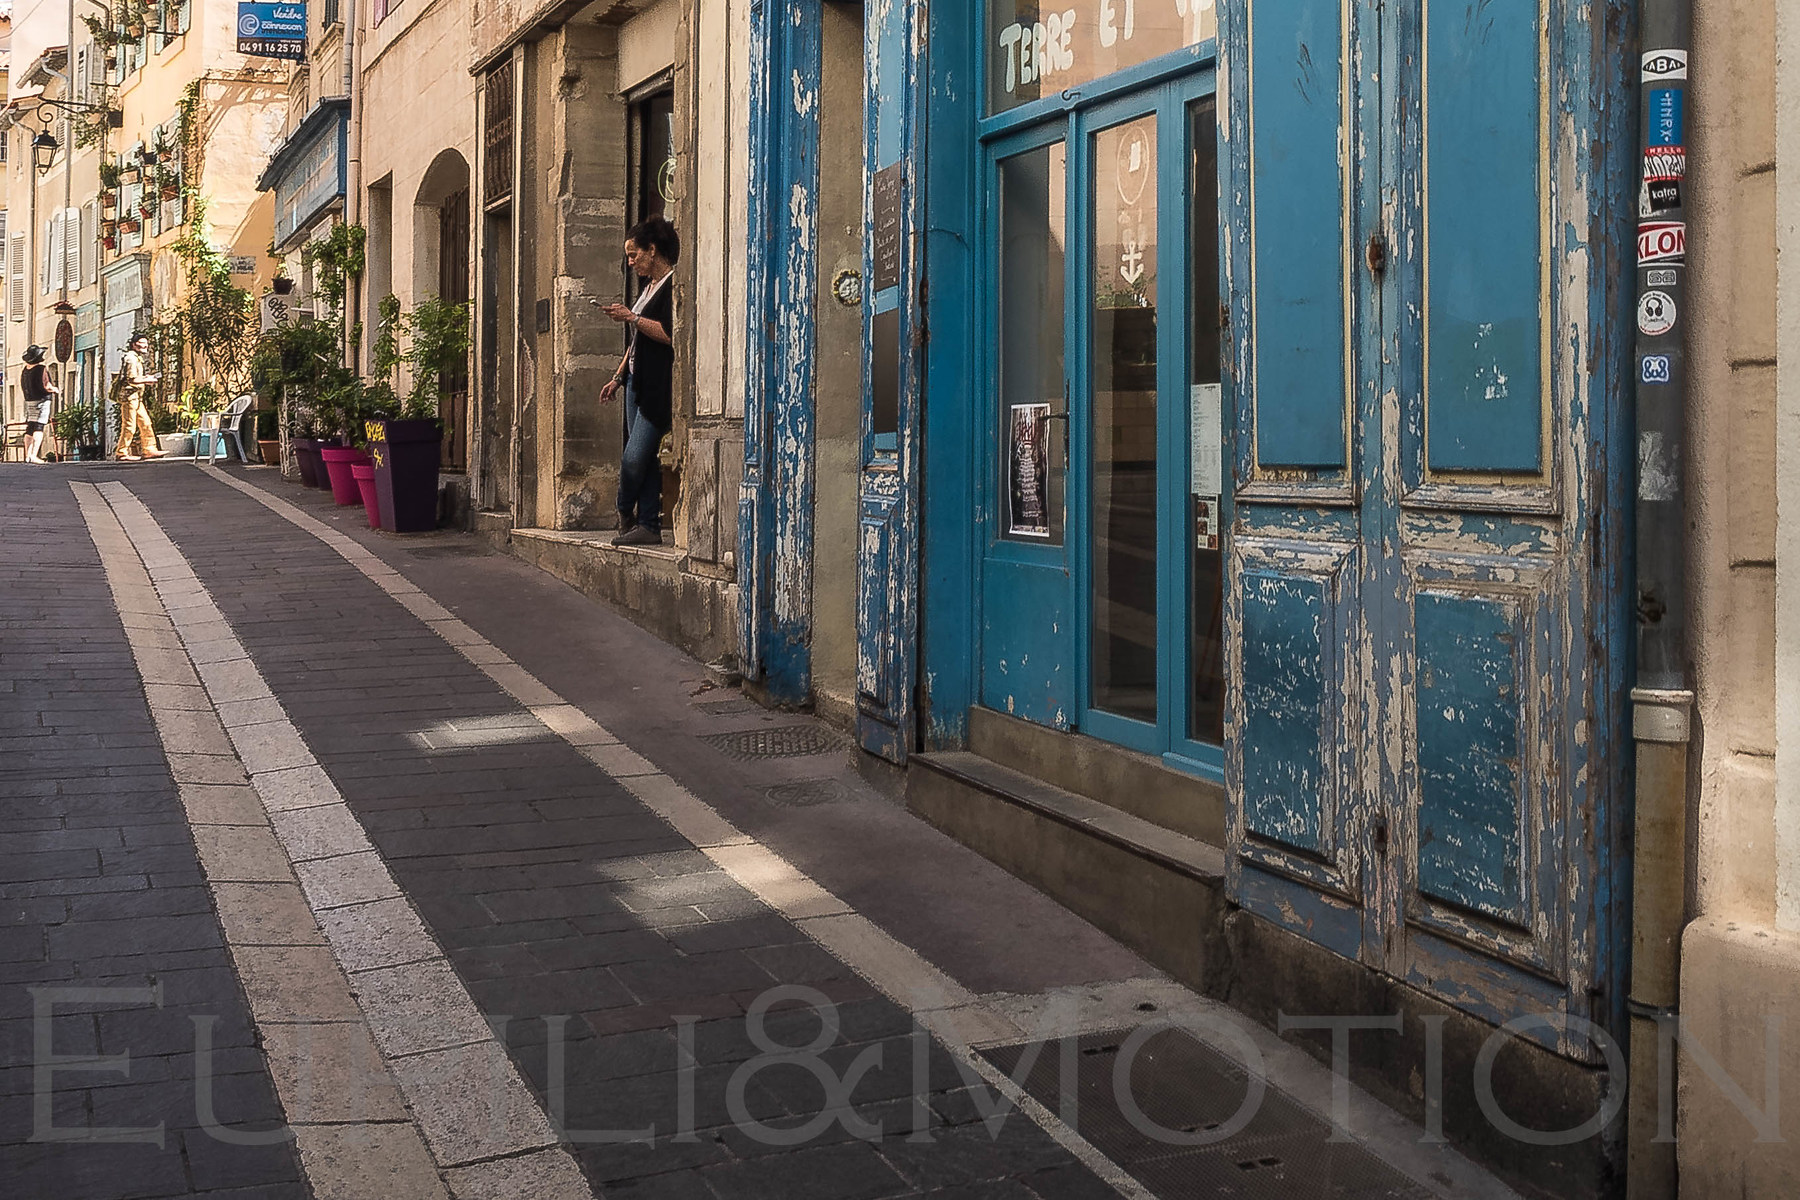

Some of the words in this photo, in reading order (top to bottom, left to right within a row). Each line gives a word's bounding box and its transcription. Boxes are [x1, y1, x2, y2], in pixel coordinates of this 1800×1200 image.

[240, 42, 251, 52] 04
[252, 42, 262, 52] 91
[265, 43, 276, 52] 16
[277, 43, 289, 53] 25
[290, 44, 302, 53] 70
[999, 8, 1077, 93] TERRE
